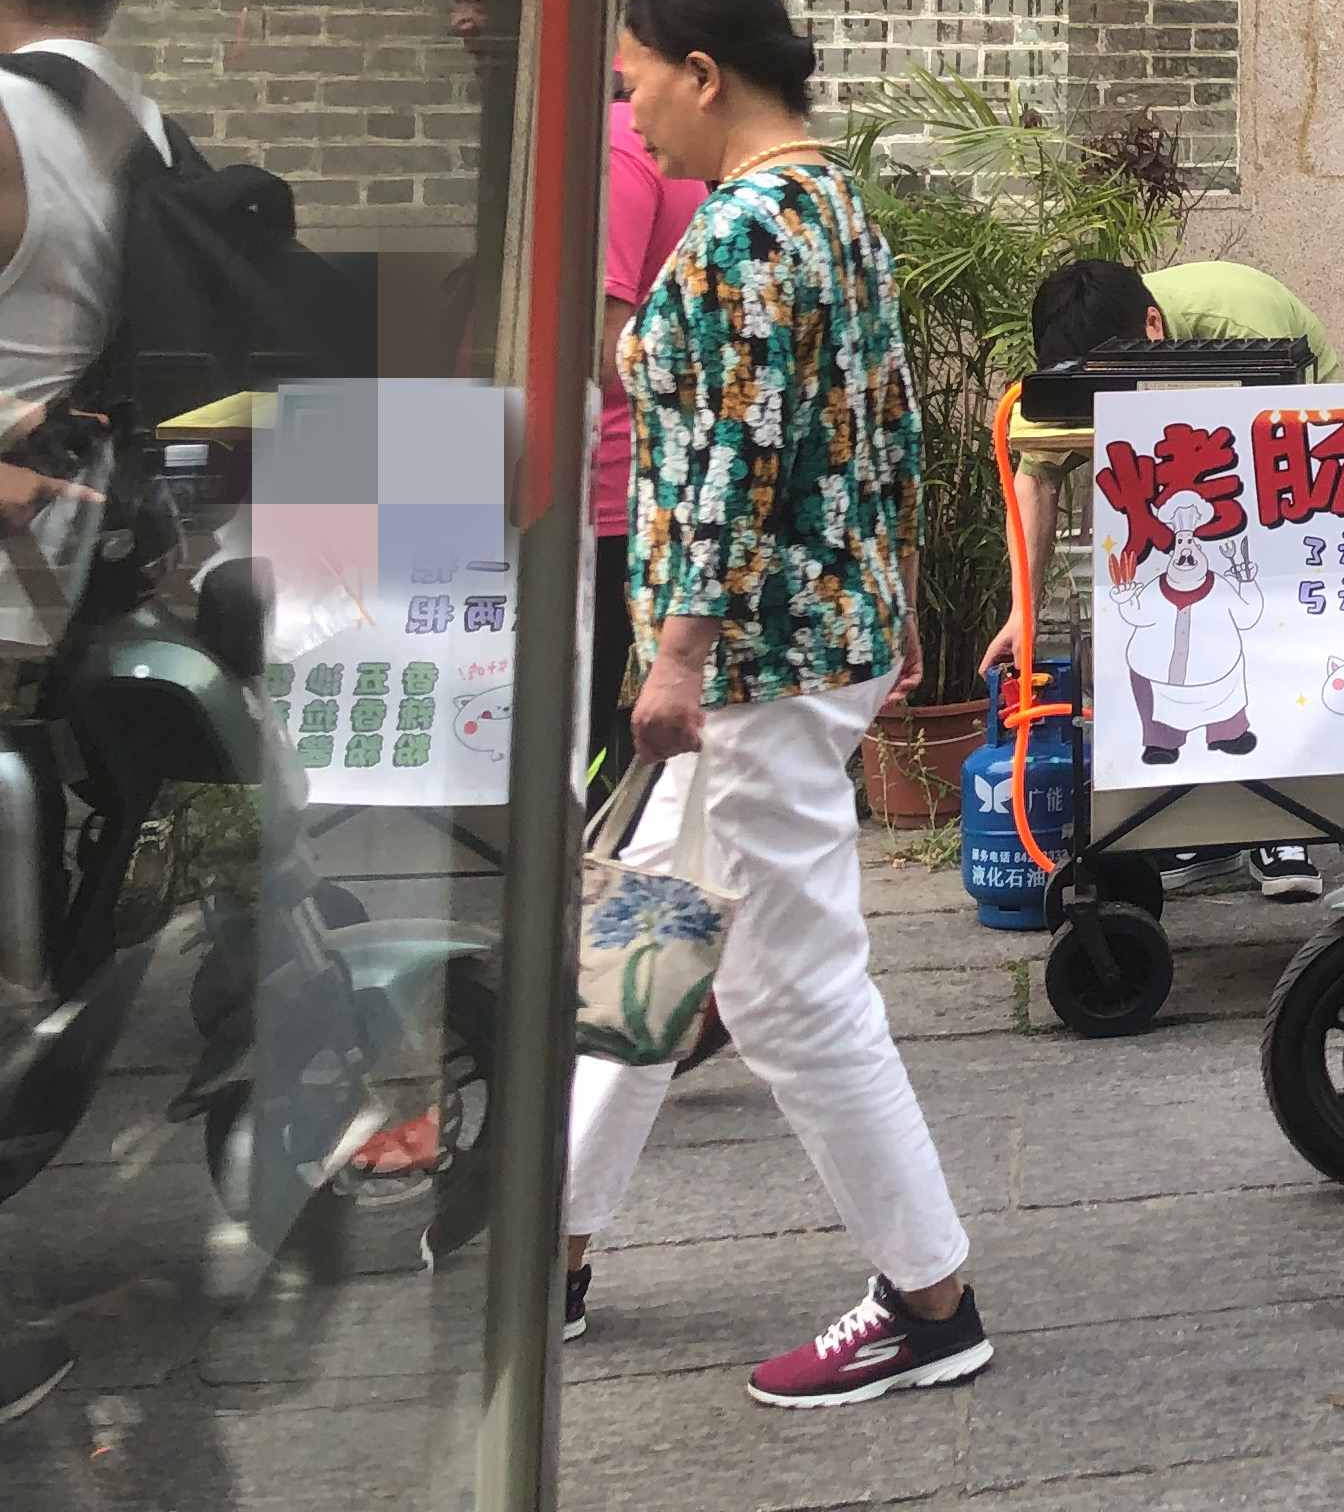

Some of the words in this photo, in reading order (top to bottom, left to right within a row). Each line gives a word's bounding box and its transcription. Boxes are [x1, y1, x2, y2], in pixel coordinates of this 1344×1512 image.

[971, 847, 1011, 863] 服务电话
[971, 865, 1046, 888] 液化石油
